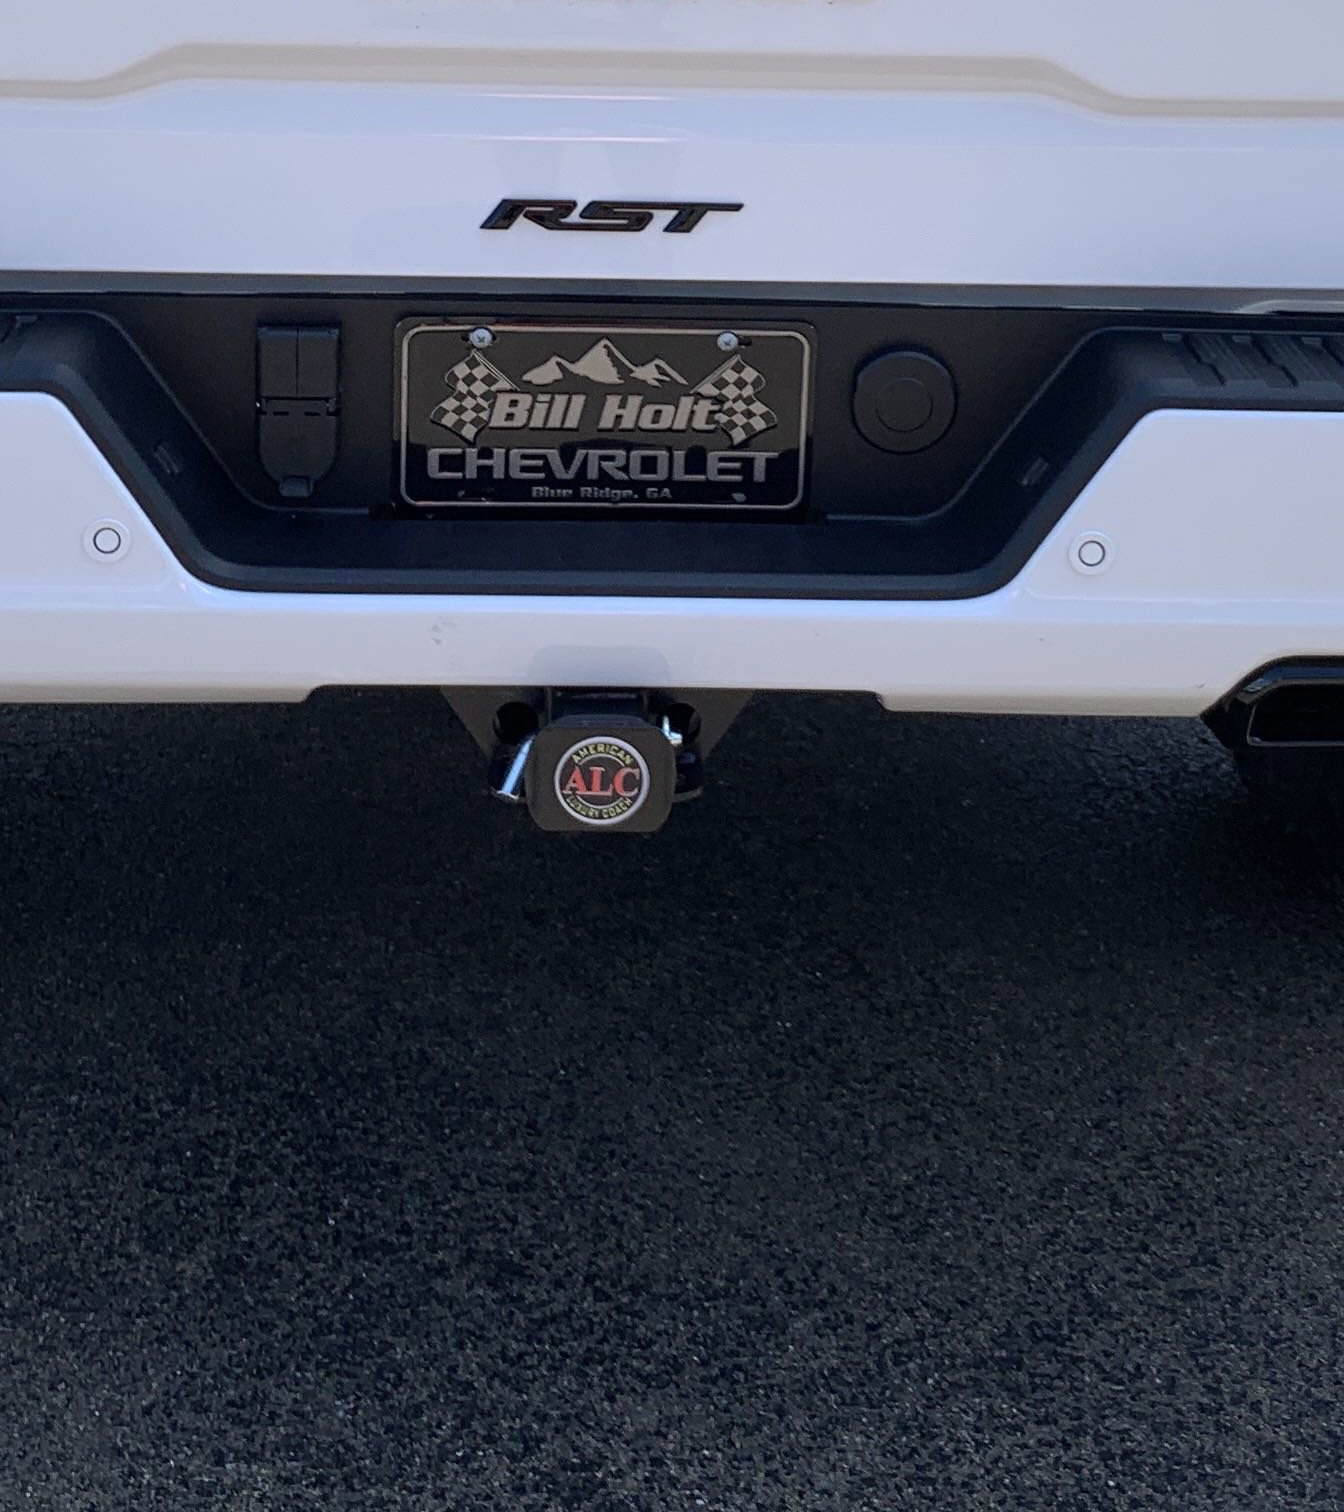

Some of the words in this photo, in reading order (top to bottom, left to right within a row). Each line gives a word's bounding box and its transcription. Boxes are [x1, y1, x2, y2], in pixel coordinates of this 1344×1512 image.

[479, 198, 745, 233] RST
[488, 392, 585, 430] Bill
[596, 393, 724, 432] Holt
[427, 447, 779, 483] CHEVROLET
[531, 486, 573, 499] Blue
[645, 487, 673, 499] GA
[571, 743, 634, 764] AMERICAN
[562, 766, 640, 797] ALC
